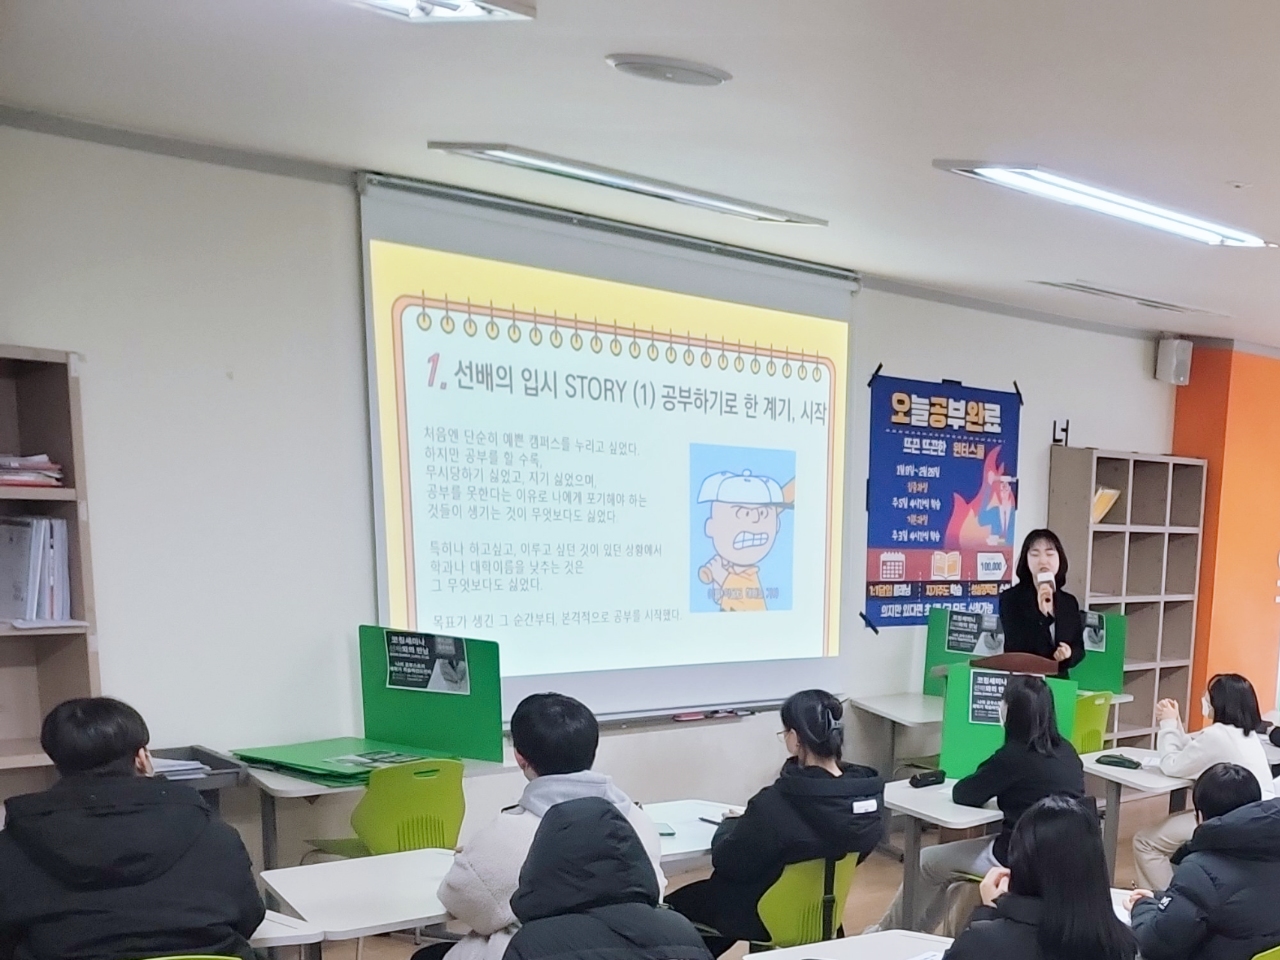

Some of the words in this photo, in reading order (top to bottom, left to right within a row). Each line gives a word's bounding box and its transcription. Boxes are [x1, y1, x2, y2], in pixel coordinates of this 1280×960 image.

[454, 360, 514, 394] 선배의
[521, 368, 558, 399] 입시
[565, 373, 627, 403] STORY
[633, 380, 655, 410] (1)
[661, 384, 739, 416] 공부하기로
[744, 393, 759, 419] 한
[763, 396, 795, 423] 계기,
[800, 400, 827, 426] 시작
[891, 392, 1001, 433] 오늘공부완료
[424, 426, 459, 444] 처음엔
[464, 429, 498, 447] 단순히
[502, 432, 524, 448] 예쁜
[528, 434, 571, 452] 캠퍼스를
[574, 438, 605, 454] 누리고
[424, 446, 459, 463] 하지만
[464, 448, 498, 466] 공부를
[425, 464, 484, 482] 무시당하기
[426, 484, 462, 501] 공부를
[466, 486, 511, 503] 못한다는
[516, 488, 548, 504] 이유로
[552, 490, 582, 506] 나에게
[586, 492, 625, 507] 포기해야
[629, 493, 647, 508] 하는
[428, 503, 463, 521] 것들이
[467, 505, 501, 521] 생기는
[505, 506, 527, 522] 것이
[531, 507, 583, 523] 무엇보다도
[579, 542, 600, 557] 것이
[470, 560, 524, 575] 대학이름을
[564, 560, 584, 575] 것은
[447, 577, 504, 593] 무엇보다도
[433, 614, 467, 630] 목표가
[472, 613, 494, 628] 생긴
[561, 611, 609, 626] 본격적으로
[613, 610, 641, 624] 공부를
